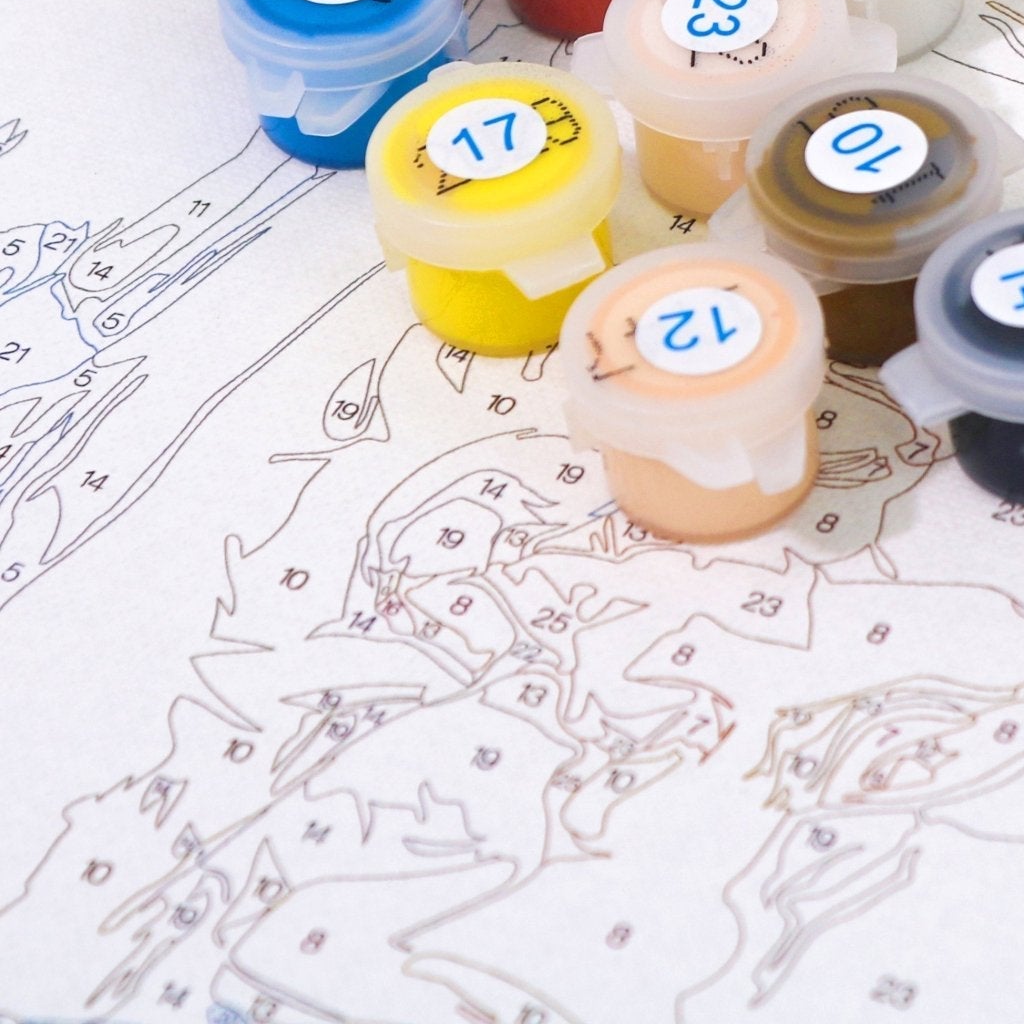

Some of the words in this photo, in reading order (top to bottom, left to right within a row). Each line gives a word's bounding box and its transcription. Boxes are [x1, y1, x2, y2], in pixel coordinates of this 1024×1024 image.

[453, 113, 516, 160] 17
[832, 123, 901, 173] 10
[189, 200, 211, 217] 11
[670, 214, 697, 234] 14
[2, 239, 25, 256] 5
[43, 233, 77, 253] 21
[87, 261, 113, 280] 14
[102, 313, 125, 329] 5
[661, 307, 735, 350] 12
[0, 342, 31, 363] 21
[74, 369, 97, 387] 5
[332, 400, 359, 420] 19
[488, 395, 516, 415] 10
[816, 410, 837, 429] 8
[908, 442, 930, 460] 7
[81, 471, 109, 491] 14
[557, 464, 585, 484] 19
[480, 478, 507, 500] 14
[816, 513, 839, 533] 8
[437, 528, 465, 549] 19
[503, 529, 530, 546] 13
[280, 568, 309, 590] 10
[450, 596, 473, 615] 8
[741, 591, 783, 617] 23
[349, 611, 377, 632] 14
[530, 607, 571, 633] 25
[867, 623, 890, 644] 8
[671, 645, 695, 665] 8
[518, 683, 547, 707] 13
[224, 739, 254, 762] 10
[82, 860, 113, 884] 10
